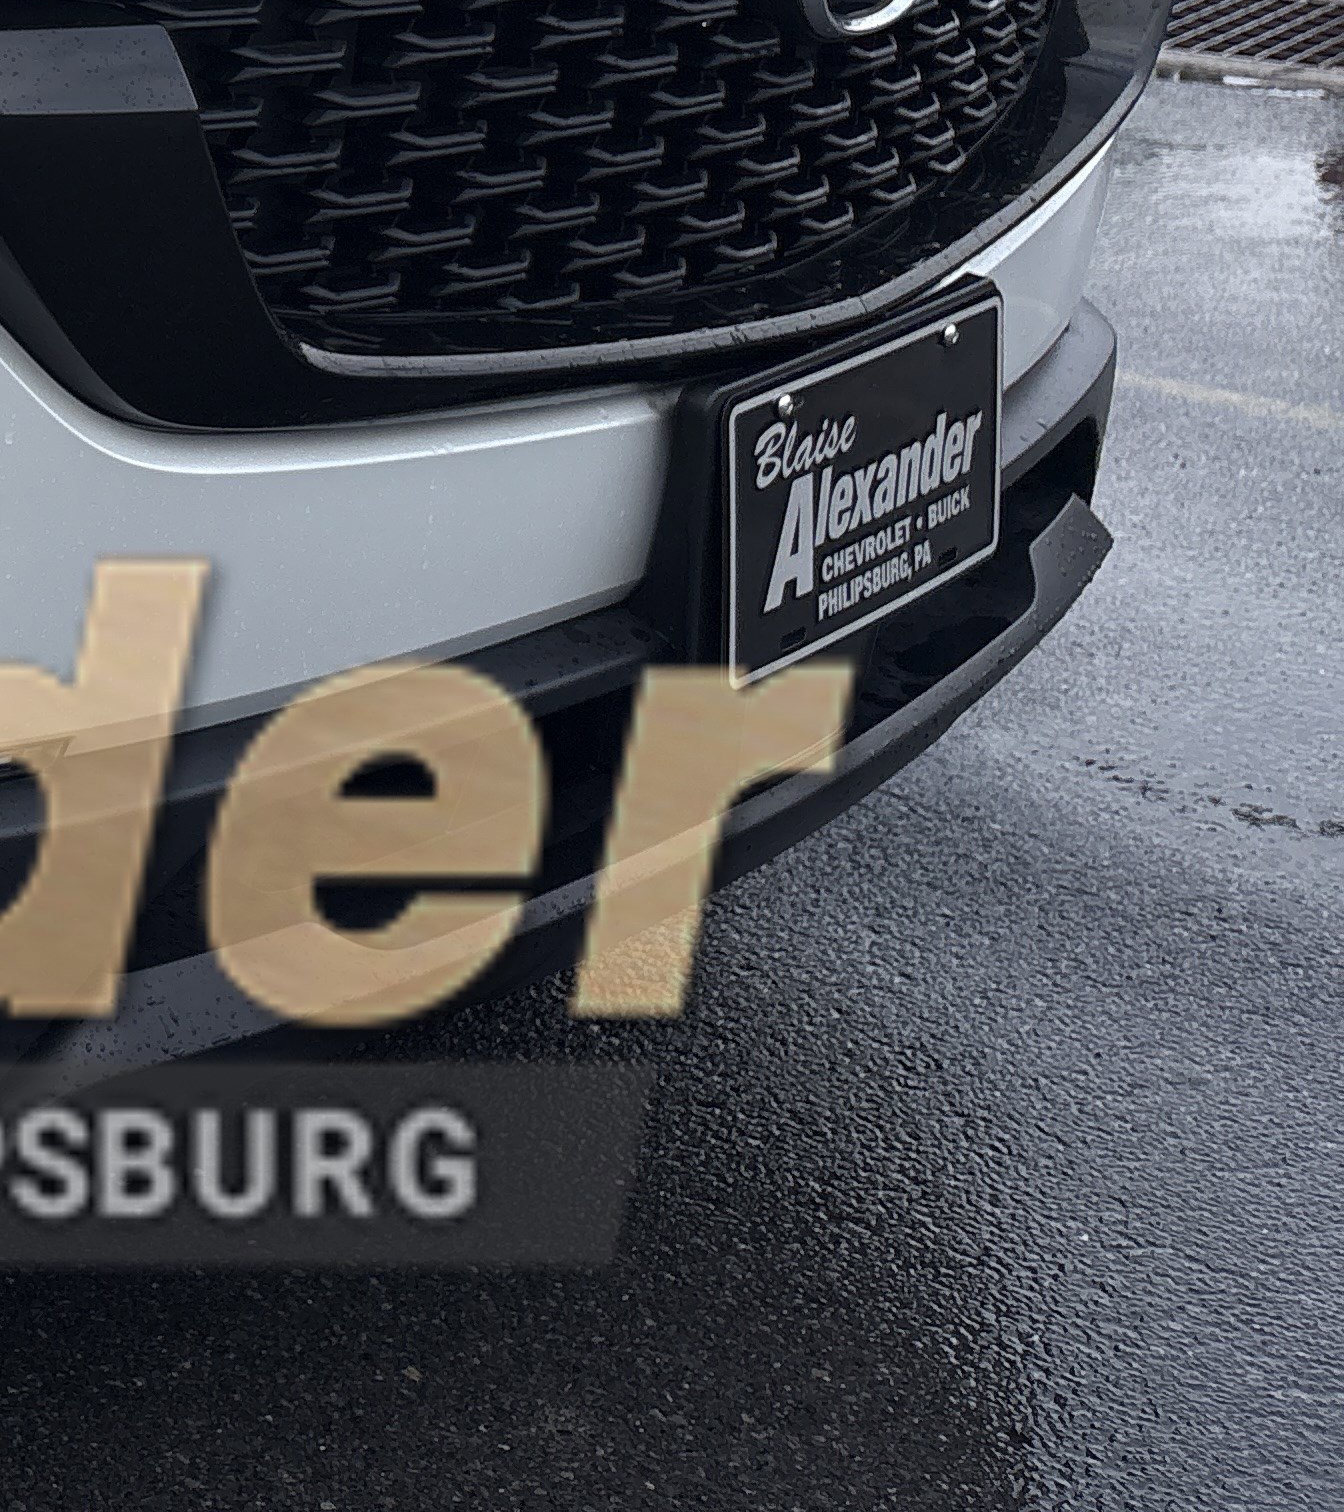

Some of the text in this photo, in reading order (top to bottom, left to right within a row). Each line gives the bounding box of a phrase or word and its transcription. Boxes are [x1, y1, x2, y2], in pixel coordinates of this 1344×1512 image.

[753, 415, 857, 491] Blaise
[763, 410, 983, 614] Alexander
[820, 484, 972, 583] CHEVROLET BUICK
[817, 538, 933, 622] PHILIPSBURG, PA
